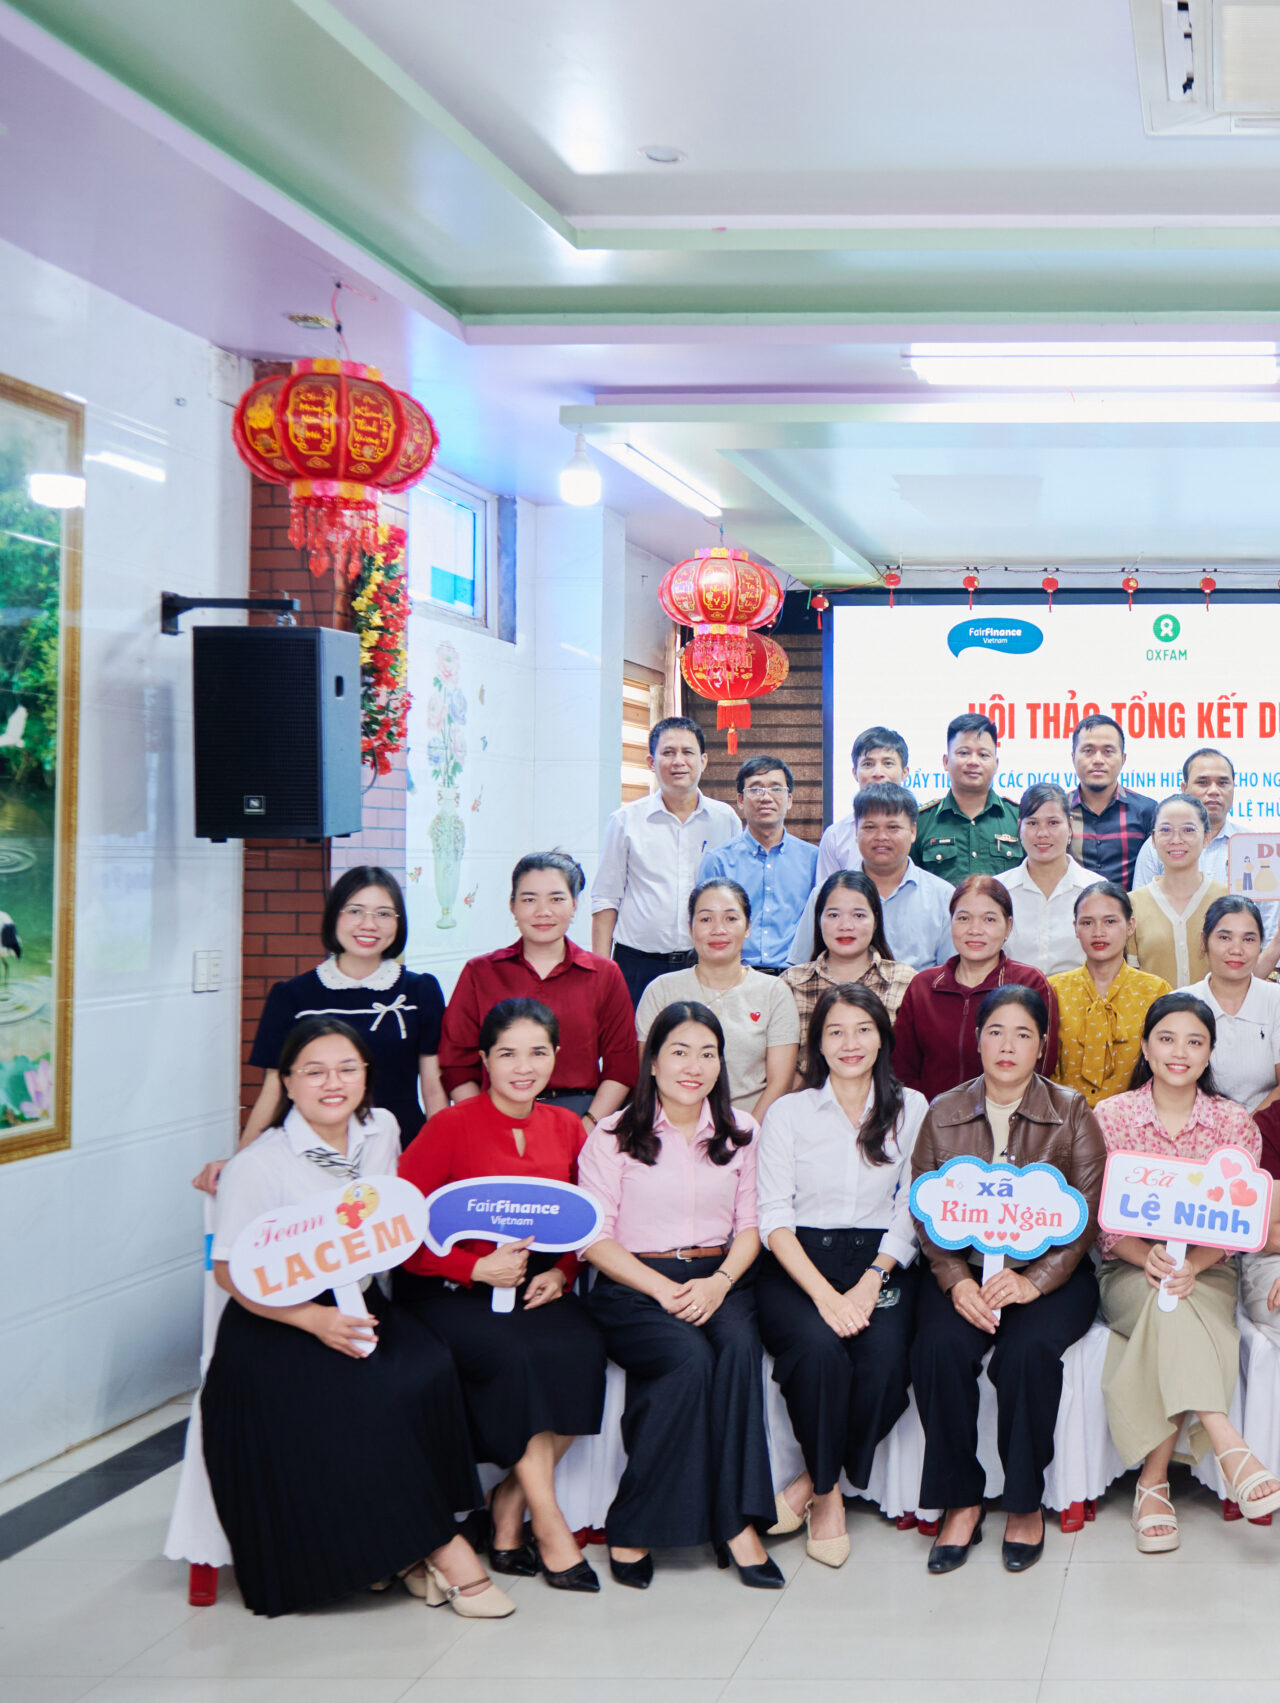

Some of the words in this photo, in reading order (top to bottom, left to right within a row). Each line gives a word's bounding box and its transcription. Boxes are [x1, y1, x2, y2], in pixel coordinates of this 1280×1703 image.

[968, 627, 1022, 637] FairFinance
[1146, 649, 1188, 661] OXFAM
[1111, 690, 1186, 739] TỔNG
[1197, 692, 1248, 739] KẾT
[998, 769, 1024, 788] CÁC
[1120, 769, 1156, 788] HÍNH
[1238, 798, 1254, 821] LỆ
[976, 1177, 1014, 1198] xã
[1124, 1166, 1179, 1188] Xã
[466, 1198, 561, 1215] FairFinance
[940, 1199, 989, 1224] Kim
[997, 1202, 1062, 1232] Ngân
[1119, 1193, 1161, 1227] Lệ
[1174, 1200, 1250, 1235] Ninh
[254, 1214, 324, 1248] Team
[490, 1214, 534, 1226] Vietnam
[252, 1213, 416, 1298] LACEM
